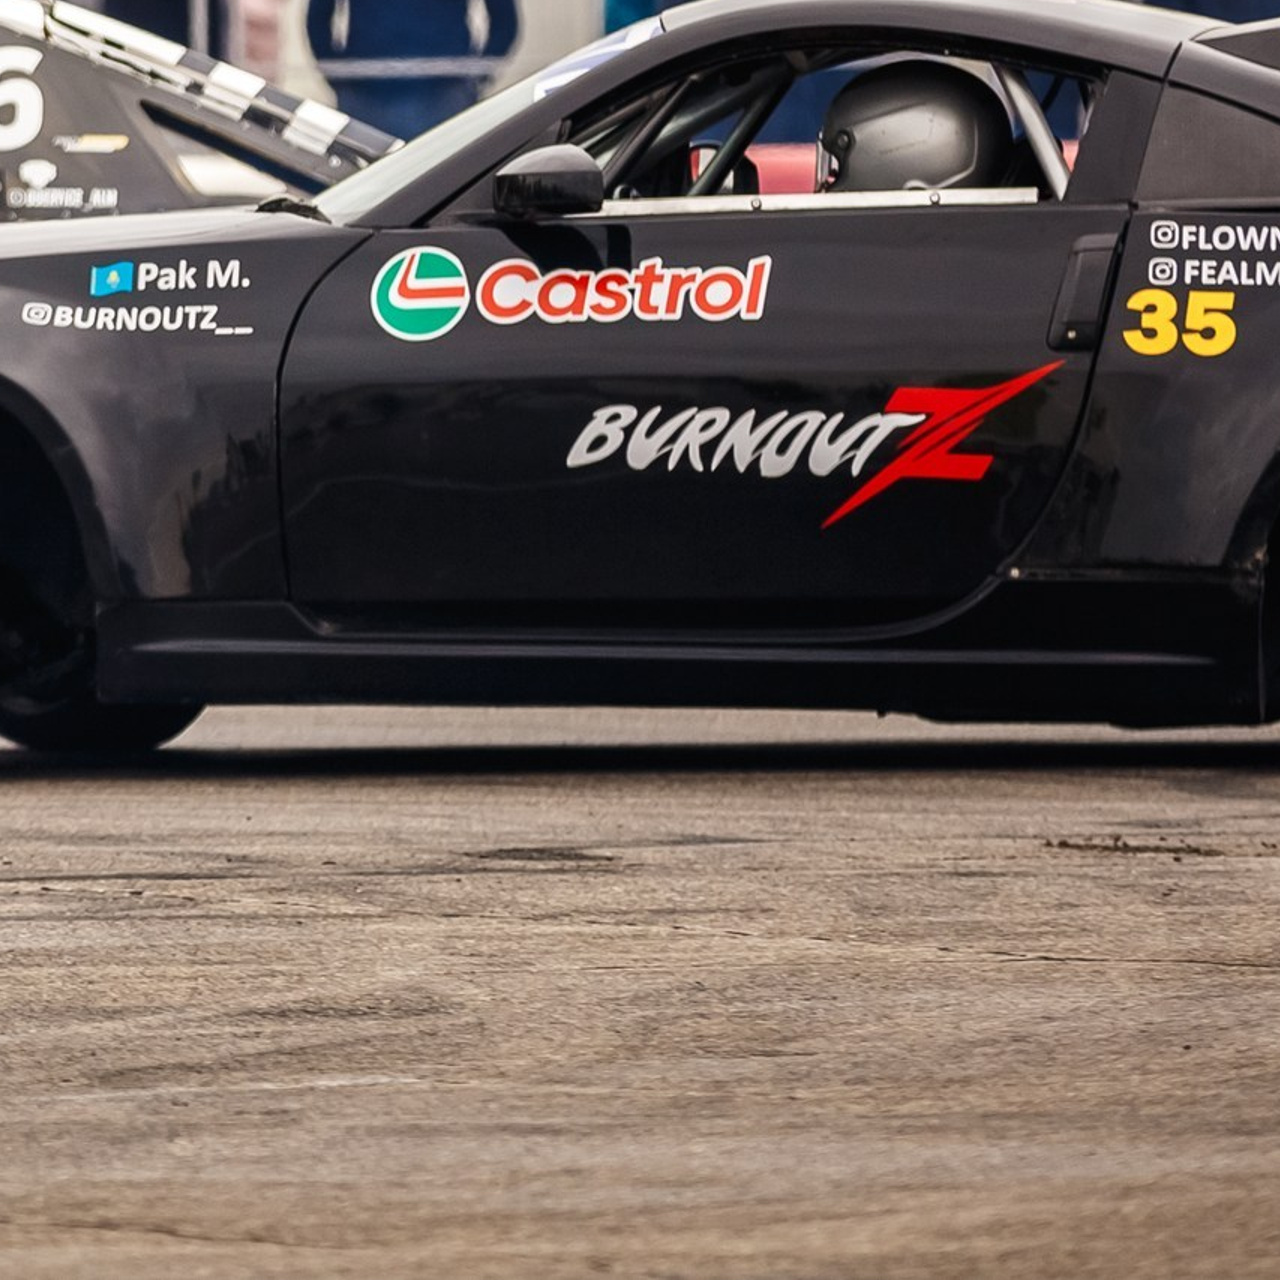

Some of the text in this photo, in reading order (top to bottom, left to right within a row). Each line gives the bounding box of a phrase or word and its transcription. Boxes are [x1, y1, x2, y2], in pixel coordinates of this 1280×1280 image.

[137, 260, 250, 291] Pak M.
[476, 255, 771, 324] Castrol
[1123, 288, 1237, 357] 35
